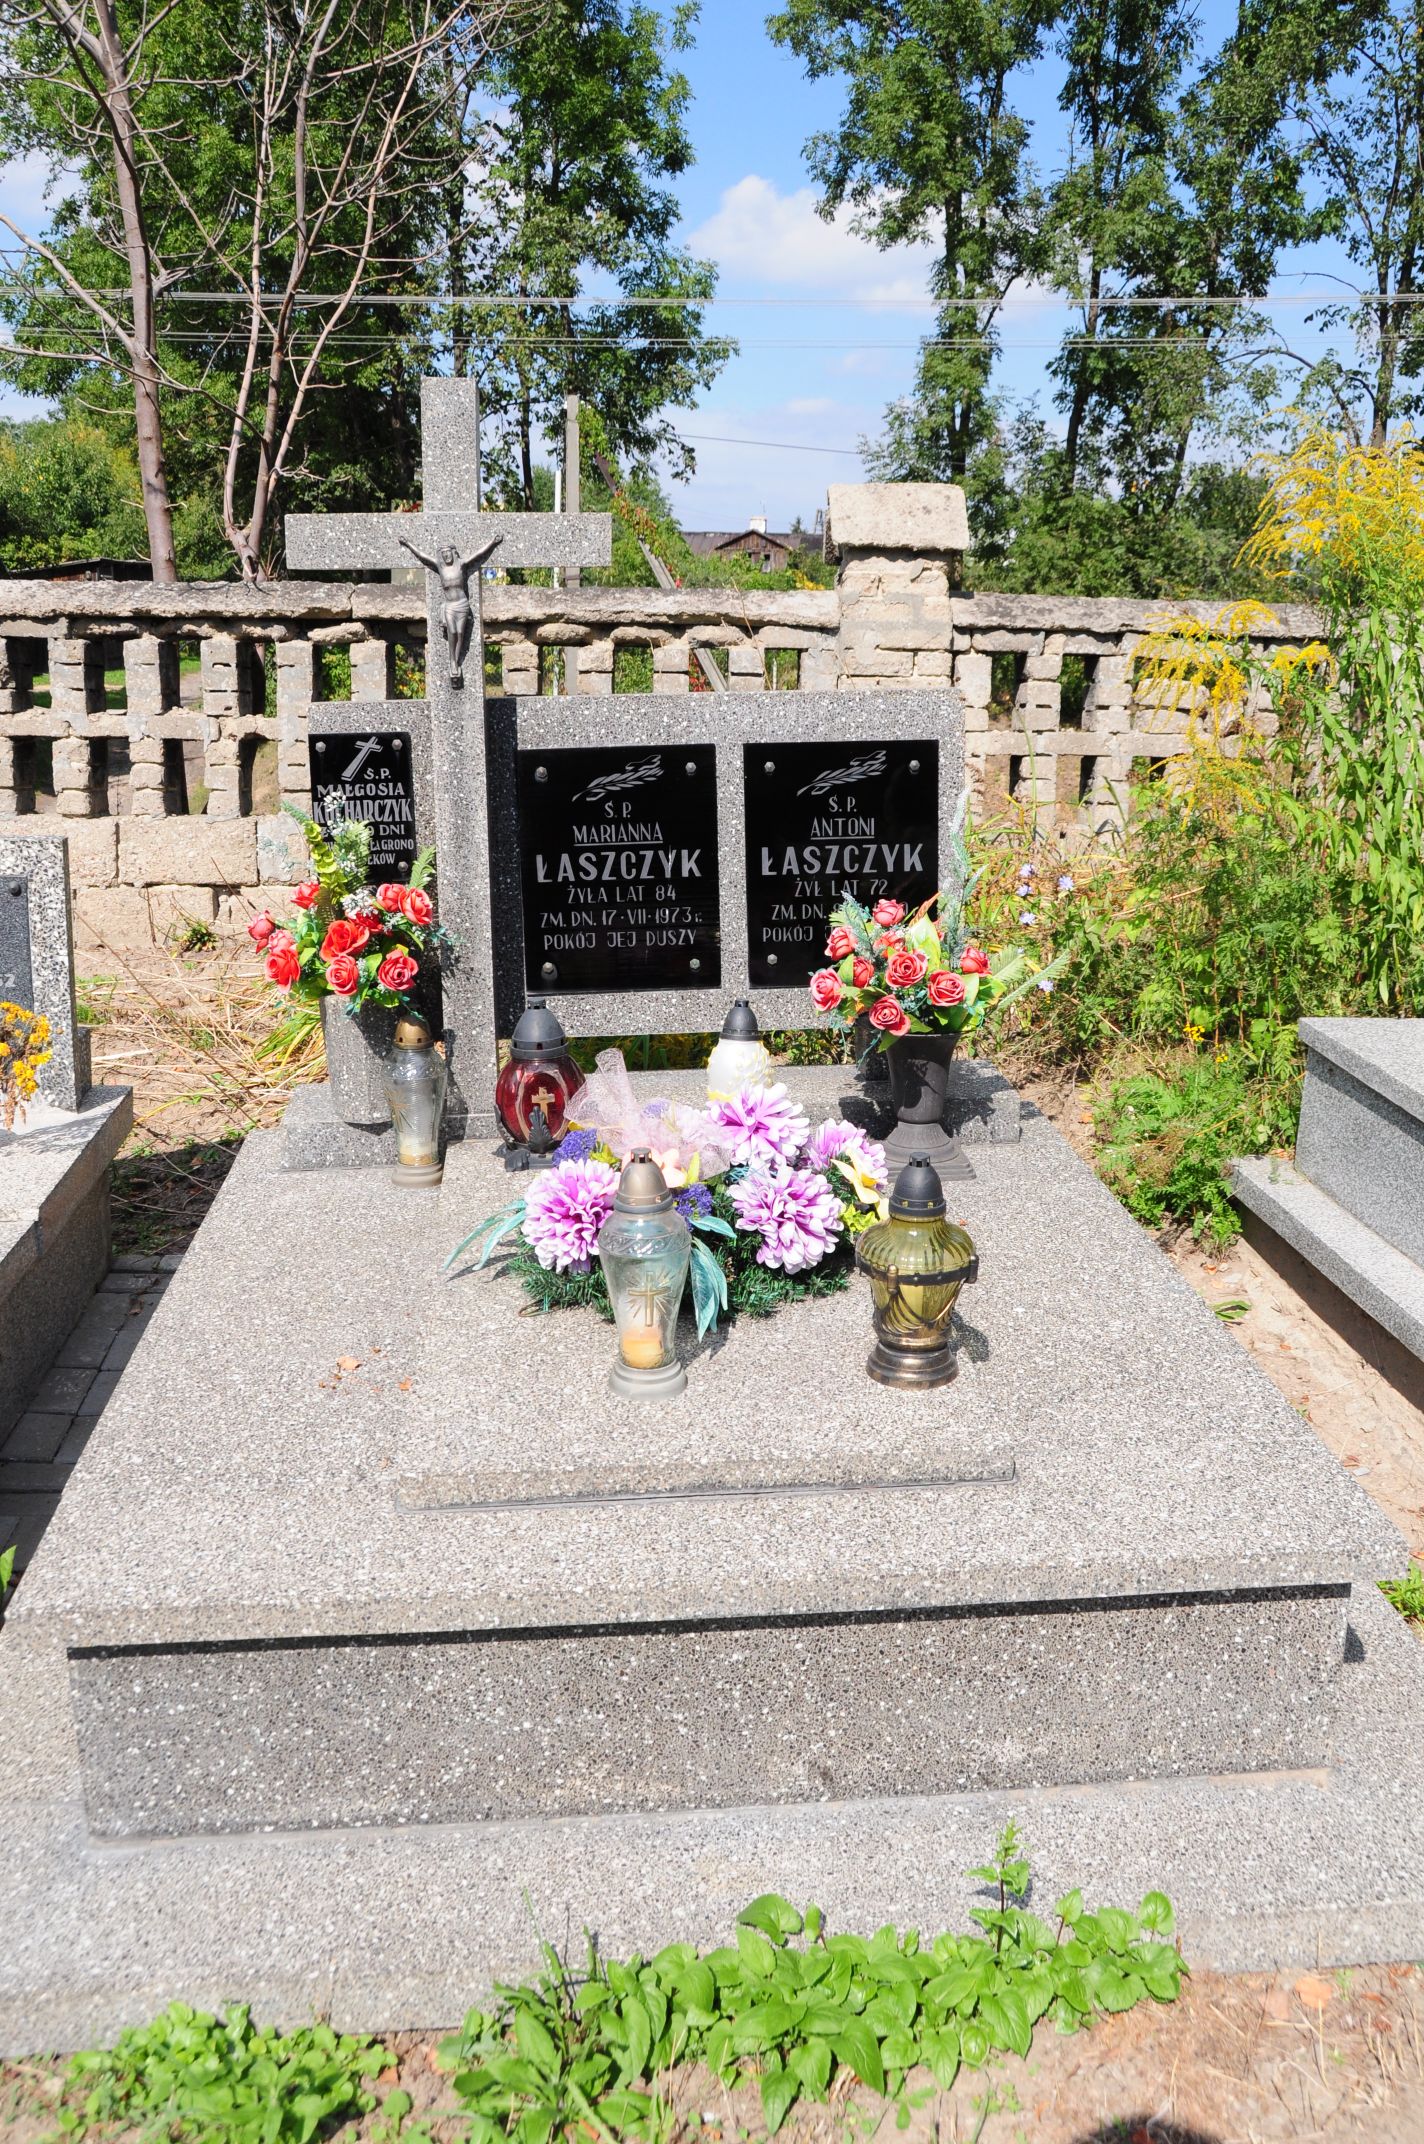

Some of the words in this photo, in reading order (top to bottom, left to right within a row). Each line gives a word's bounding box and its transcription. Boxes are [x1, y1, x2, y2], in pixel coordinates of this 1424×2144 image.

[316, 782, 405, 798] MAŁGOSIA
[847, 796, 857, 813] P.
[379, 824, 405, 836] DNI
[572, 821, 663, 843] MARIANNA
[810, 816, 875, 838] ANTONI
[381, 838, 414, 851] GRONO
[535, 848, 702, 883] ŁASZCZYK
[761, 843, 923, 876] ŁASZCZYK
[567, 884, 608, 904] ŻYŁA
[616, 885, 645, 903] LAT
[655, 884, 676, 901] 84
[794, 877, 823, 898] ŻYŁ
[831, 879, 860, 897] LAT
[870, 878, 888, 896] 72
[540, 911, 567, 928] ZM.
[571, 909, 597, 927] DN.
[771, 904, 797, 921] ZM.
[802, 903, 827, 920] DN.
[543, 931, 596, 951] POKÓJ
[607, 931, 637, 948] JEJ
[646, 928, 697, 947] DUSZY
[762, 925, 814, 943] POKÓJ
